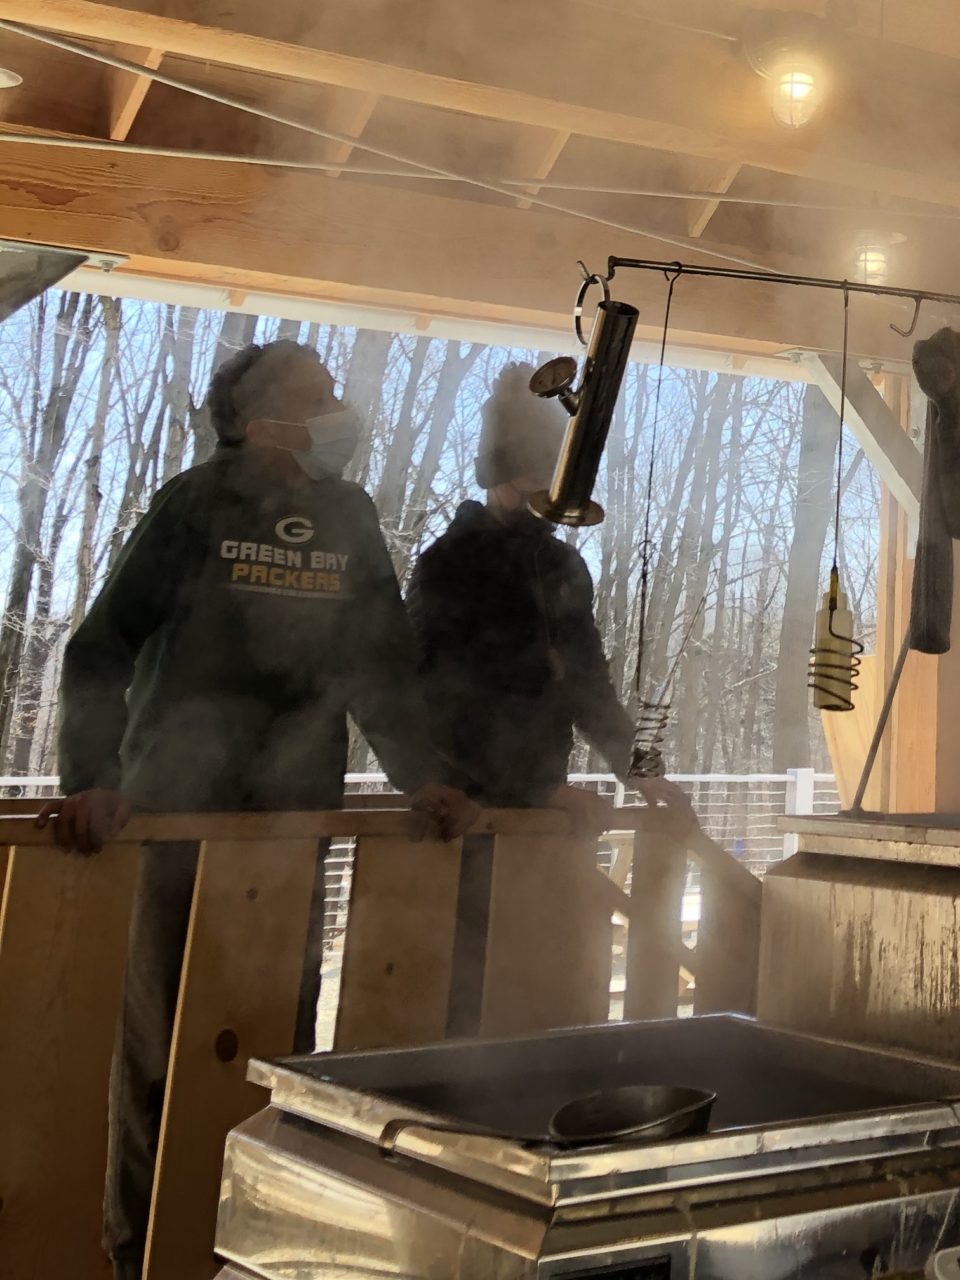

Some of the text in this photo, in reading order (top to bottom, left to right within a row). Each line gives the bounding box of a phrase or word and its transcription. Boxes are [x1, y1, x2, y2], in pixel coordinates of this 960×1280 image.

[275, 517, 314, 544] G
[220, 540, 349, 570] GREEN BAY
[231, 563, 342, 593] PACKERS
